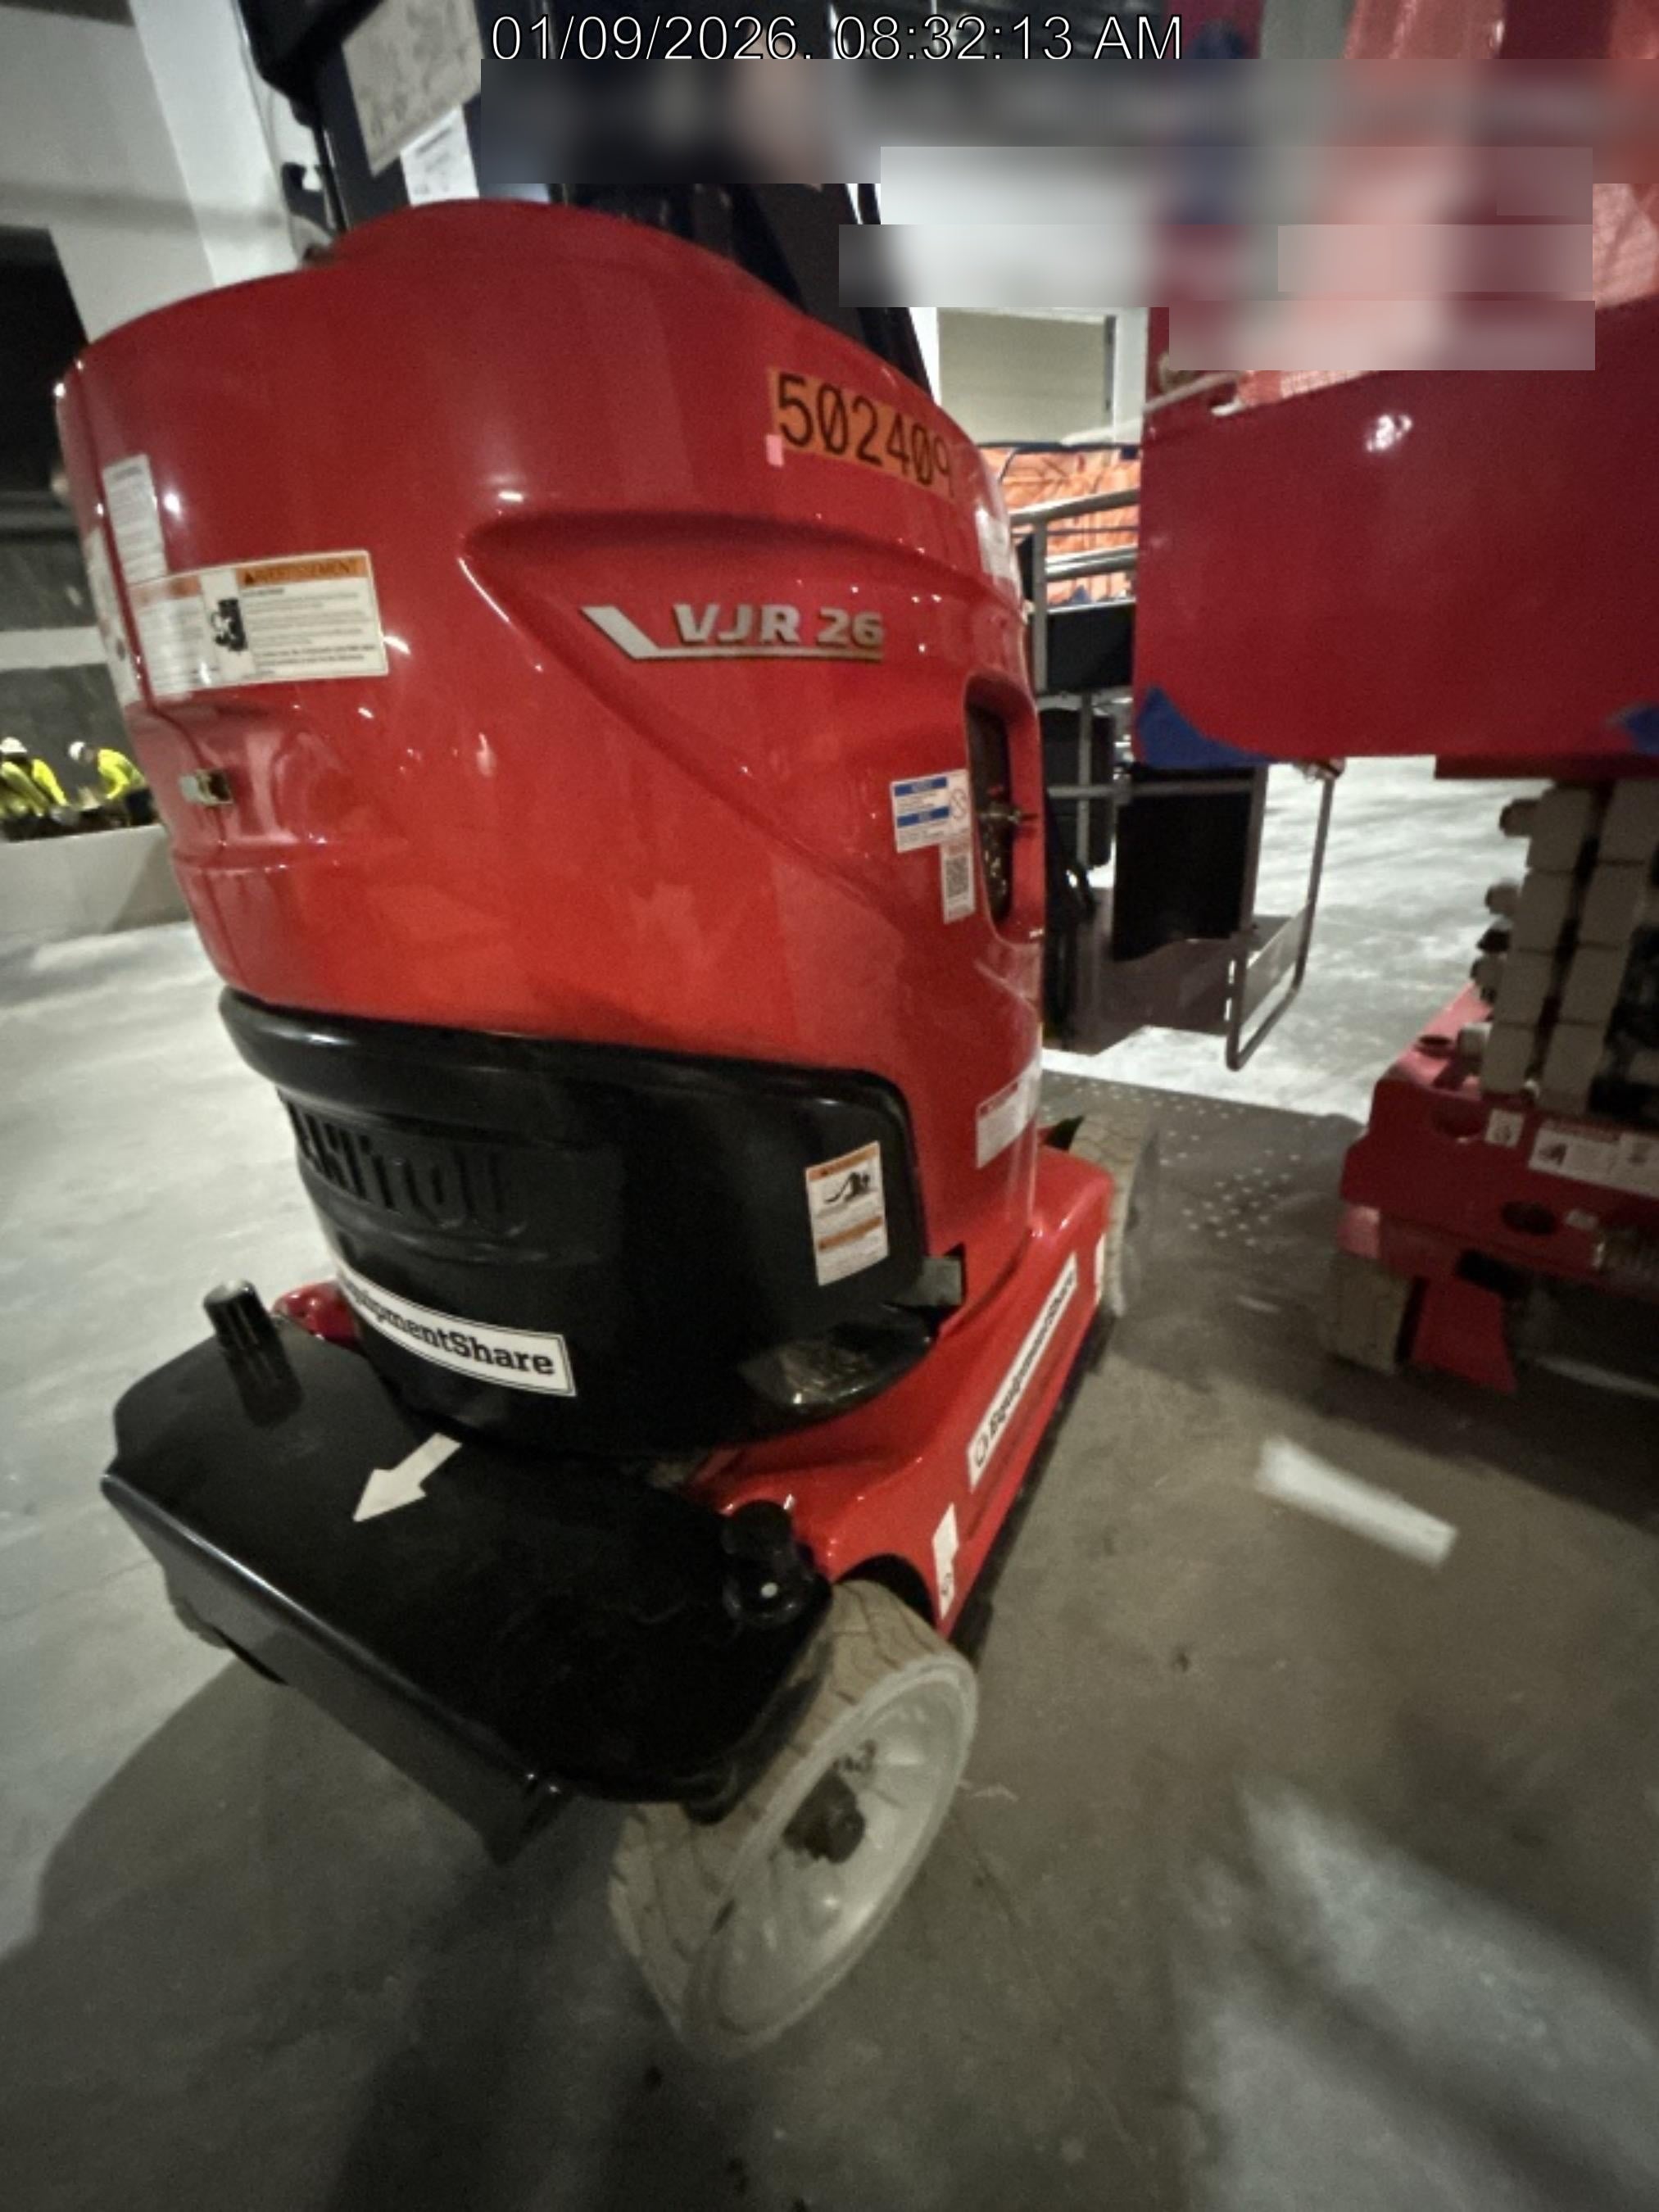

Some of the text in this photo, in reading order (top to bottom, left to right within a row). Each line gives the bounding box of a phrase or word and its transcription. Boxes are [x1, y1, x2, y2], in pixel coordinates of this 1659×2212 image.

[778, 373, 954, 498] 502409
[673, 603, 884, 646] VJR 26
